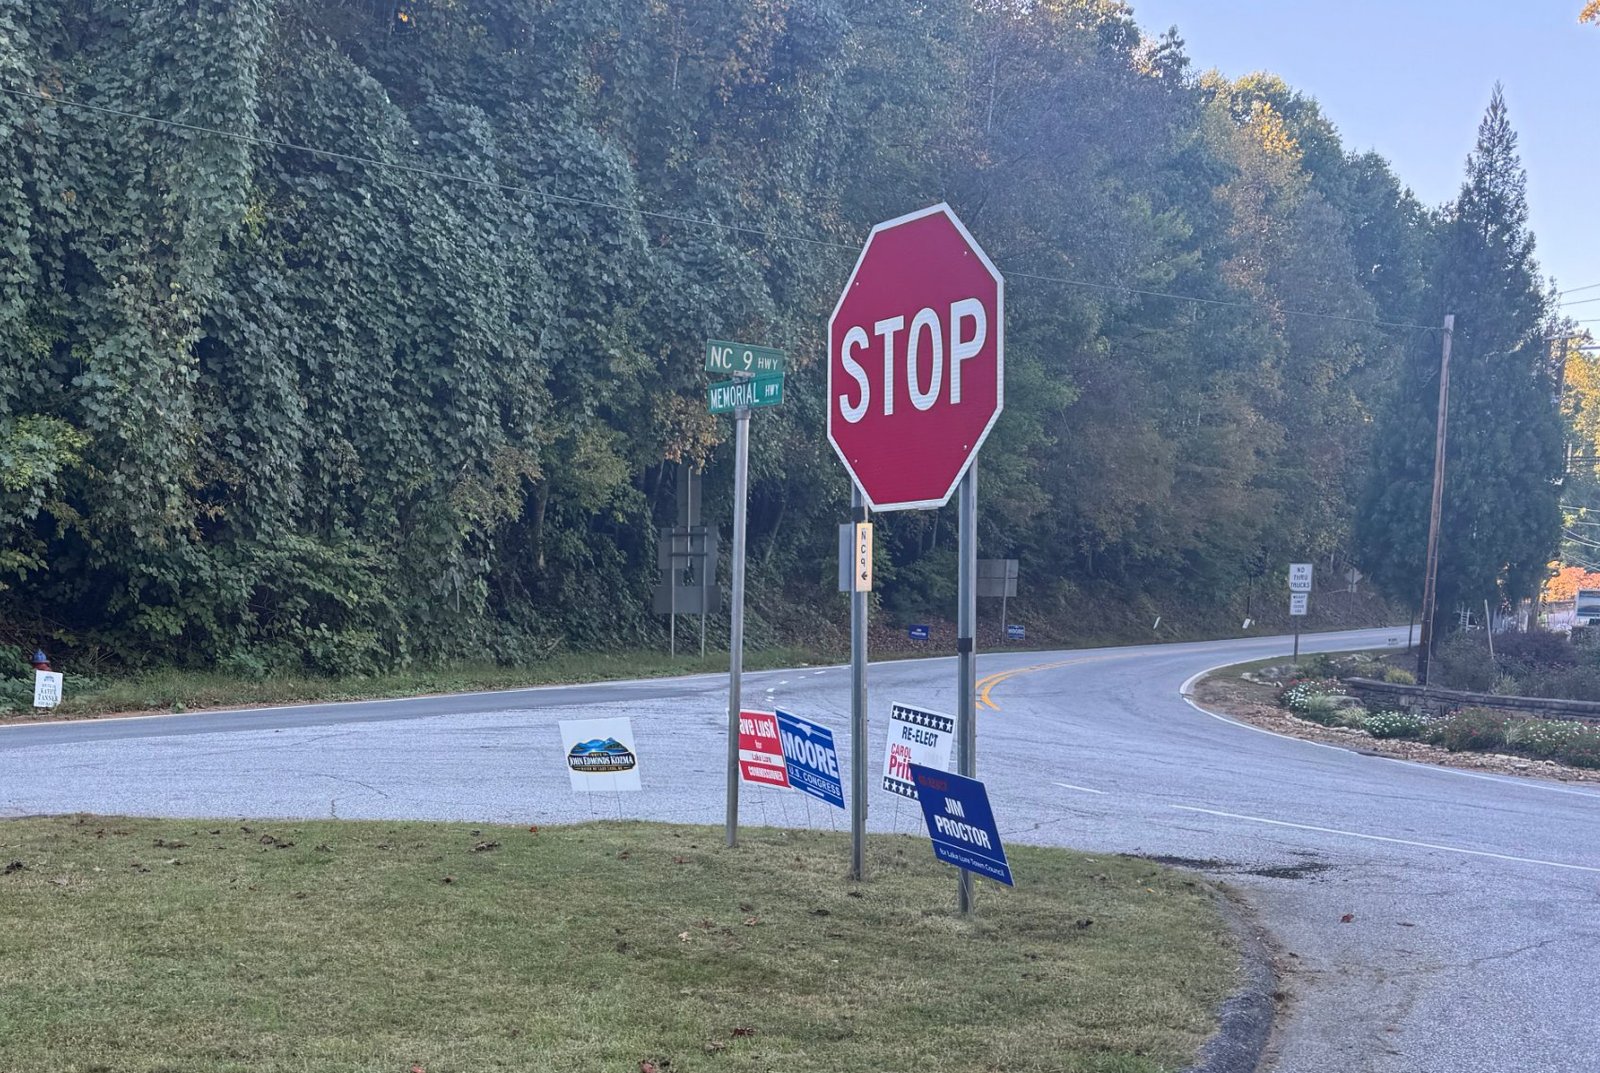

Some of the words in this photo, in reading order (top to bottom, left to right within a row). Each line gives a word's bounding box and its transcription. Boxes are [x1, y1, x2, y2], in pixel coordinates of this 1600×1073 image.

[710, 346, 733, 369] NC
[743, 351, 753, 371] 9
[757, 357, 778, 371] HWY
[839, 298, 987, 424] STOP
[711, 382, 760, 409] MEMORIAL
[765, 384, 779, 398] HWY
[902, 726, 938, 748] RE-ELECT
[611, 755, 634, 764] KOZMA
[781, 729, 840, 779] MOORE
[890, 743, 912, 759] CAROL
[789, 765, 802, 779] U.S.
[803, 772, 841, 796] CONGRESS
[944, 797, 965, 818] JIM
[933, 814, 992, 850] PROCTOR
